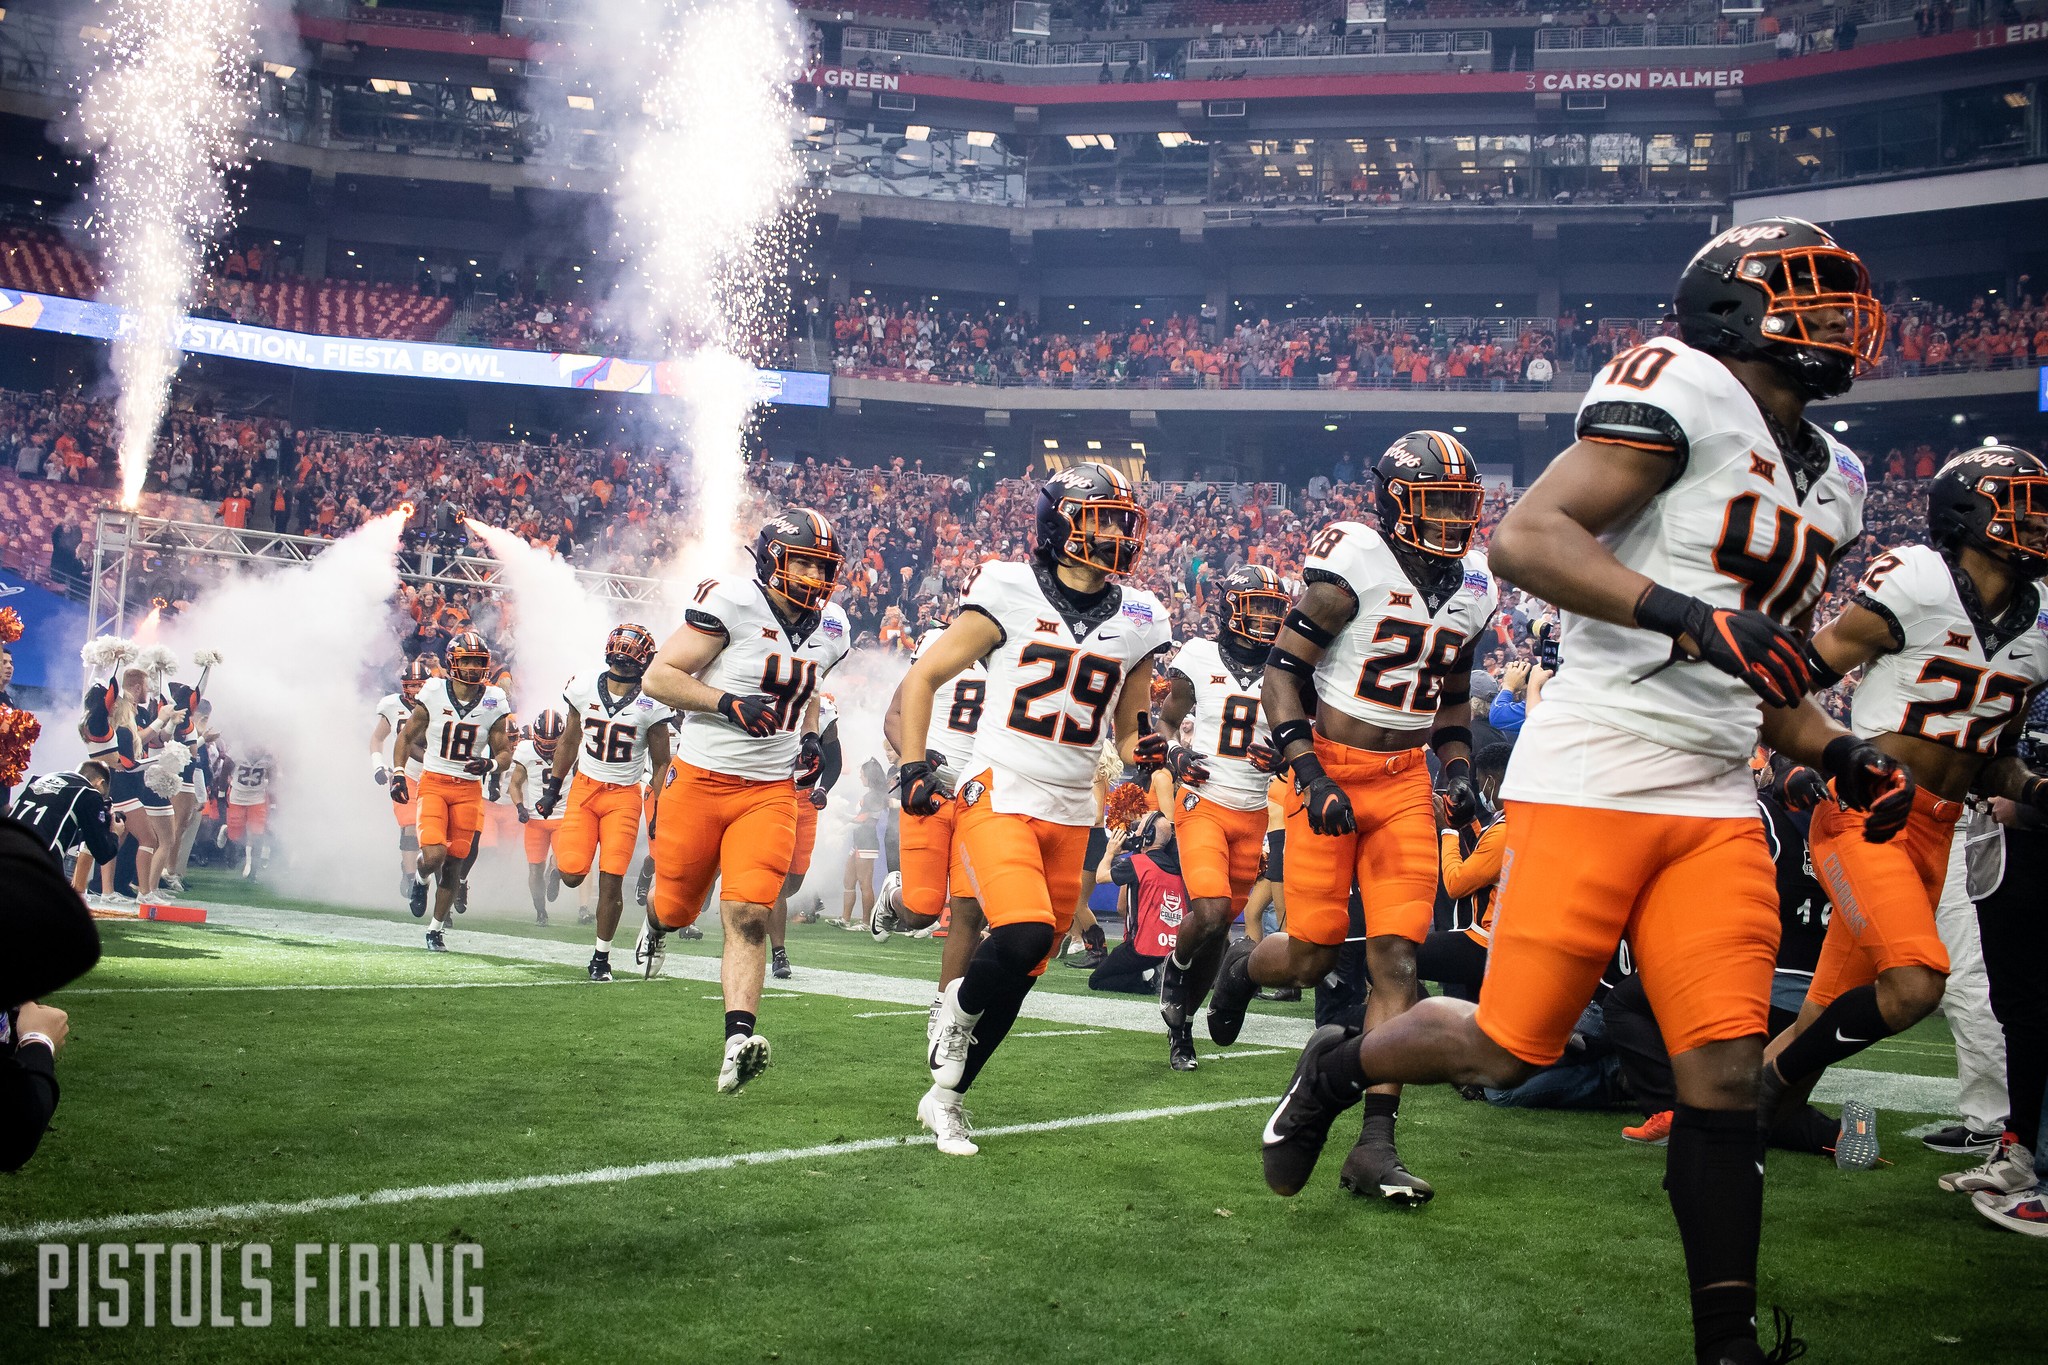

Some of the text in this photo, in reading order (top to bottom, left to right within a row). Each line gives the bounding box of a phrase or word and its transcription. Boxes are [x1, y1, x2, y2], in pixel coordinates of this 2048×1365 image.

[824, 70, 899, 90] GREEN
[1525, 69, 1745, 91] 3 CARSON PALMER
[322, 342, 415, 372] FIESTA
[421, 350, 505, 378] BOWL
[1354, 616, 1468, 714] 28
[759, 652, 818, 733] 41
[1006, 640, 1123, 747] 29
[1898, 655, 2034, 758] 22
[440, 720, 481, 762] 18
[584, 717, 638, 764] 36
[1216, 693, 1262, 758] 8
[237, 764, 265, 787] 23
[1823, 852, 1868, 938] COWBOYS
[1157, 932, 1177, 947] 05
